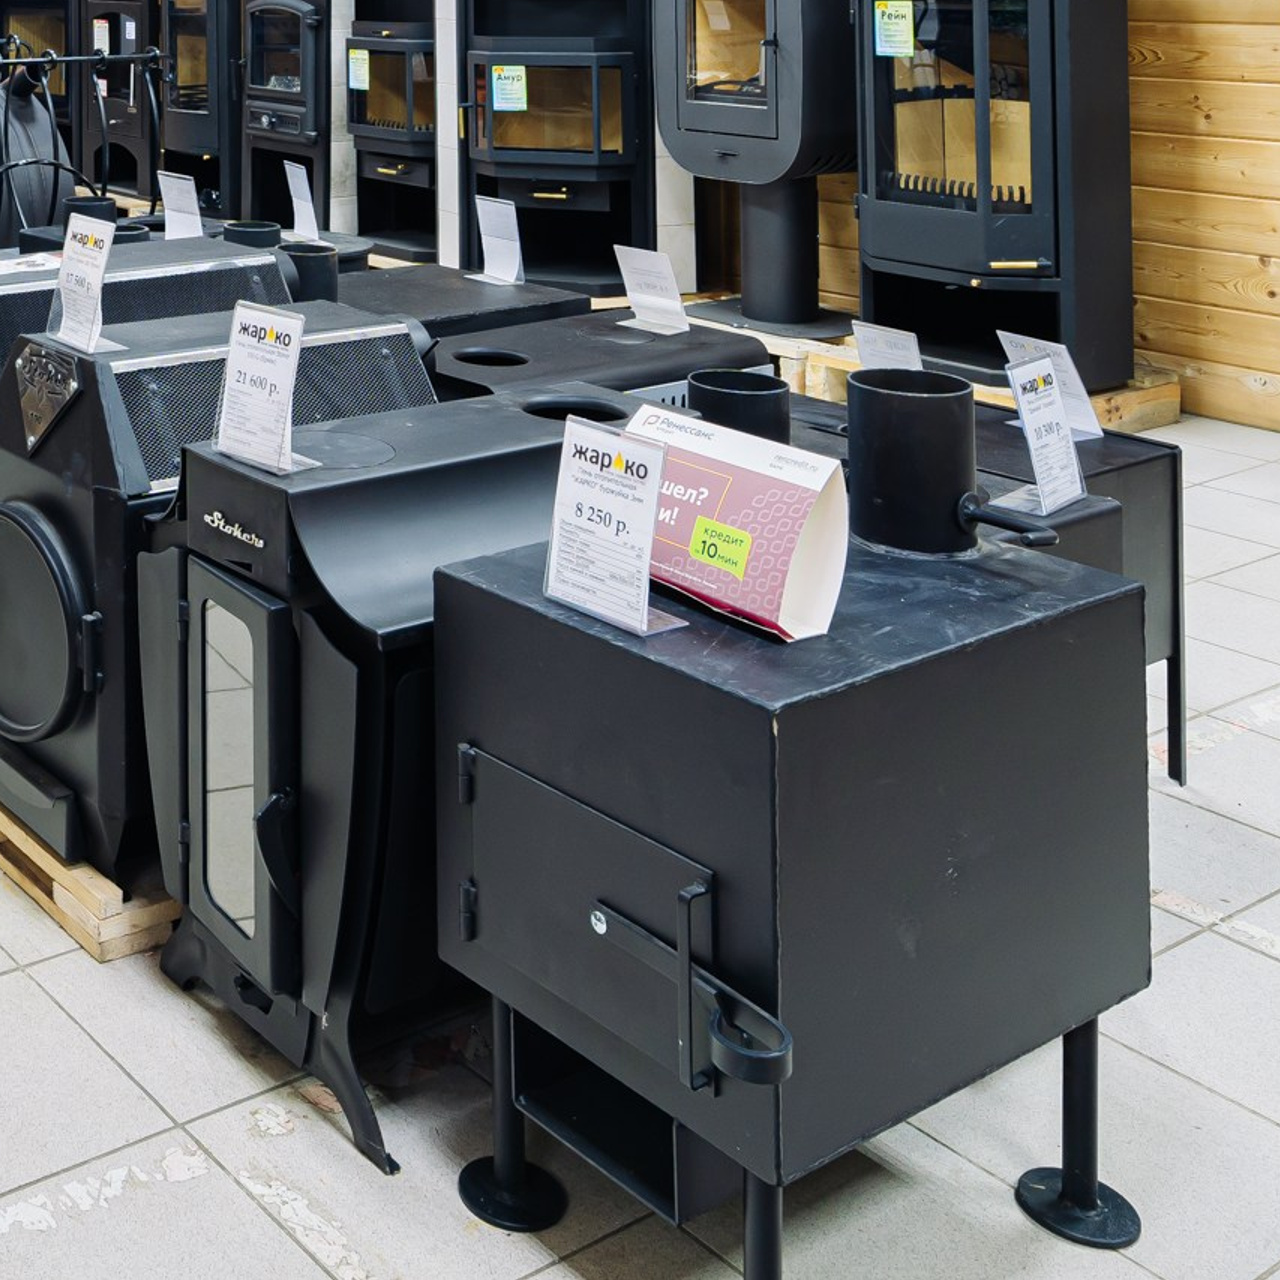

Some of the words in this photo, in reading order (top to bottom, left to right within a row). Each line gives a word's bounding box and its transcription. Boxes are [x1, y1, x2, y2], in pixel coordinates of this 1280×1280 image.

[881, 10, 907, 20] Рейн
[70, 231, 105, 250] жарко
[238, 321, 292, 347] жарко
[235, 369, 247, 385] 21
[249, 371, 268, 391] 600
[268, 381, 280, 397] р.
[1019, 372, 1054, 396] жарко
[659, 417, 715, 441] Ренессанс
[572, 443, 649, 480] жарко
[661, 479, 709, 506] шел?
[575, 502, 583, 518] 8
[587, 506, 612, 528] 250
[615, 519, 630, 536] р.
[703, 527, 745, 548] кредит
[701, 540, 718, 559] 10
[717, 554, 739, 567] мин
